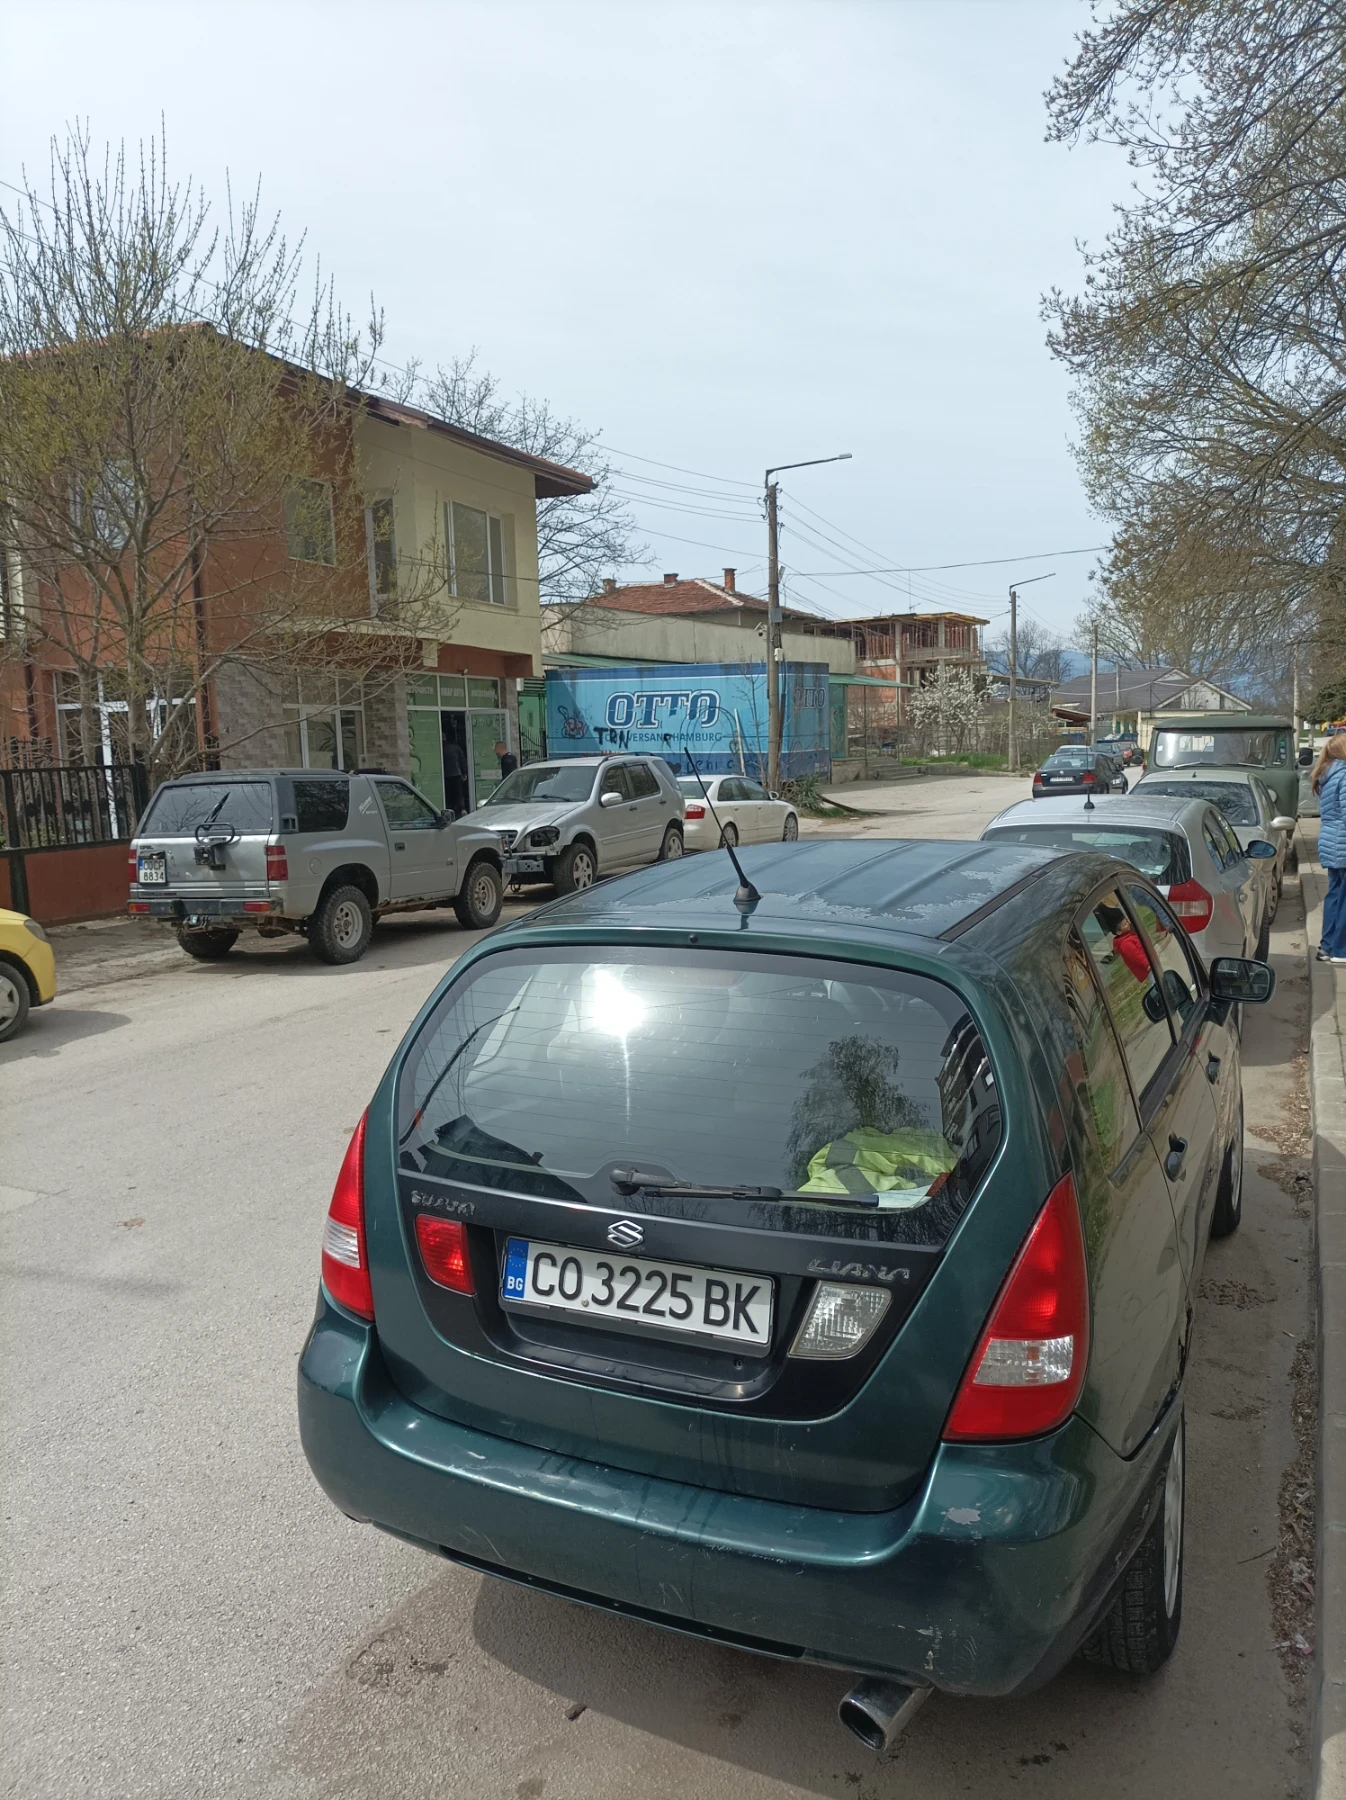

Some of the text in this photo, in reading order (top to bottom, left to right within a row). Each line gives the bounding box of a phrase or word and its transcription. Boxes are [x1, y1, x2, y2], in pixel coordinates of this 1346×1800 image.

[605, 689, 721, 729] OTTO
[673, 732, 722, 742] HAMBURG
[143, 871, 164, 882] 8834
[506, 1275, 524, 1291] BG
[591, 1261, 693, 1320] 3225
[703, 1277, 761, 1334] BK
